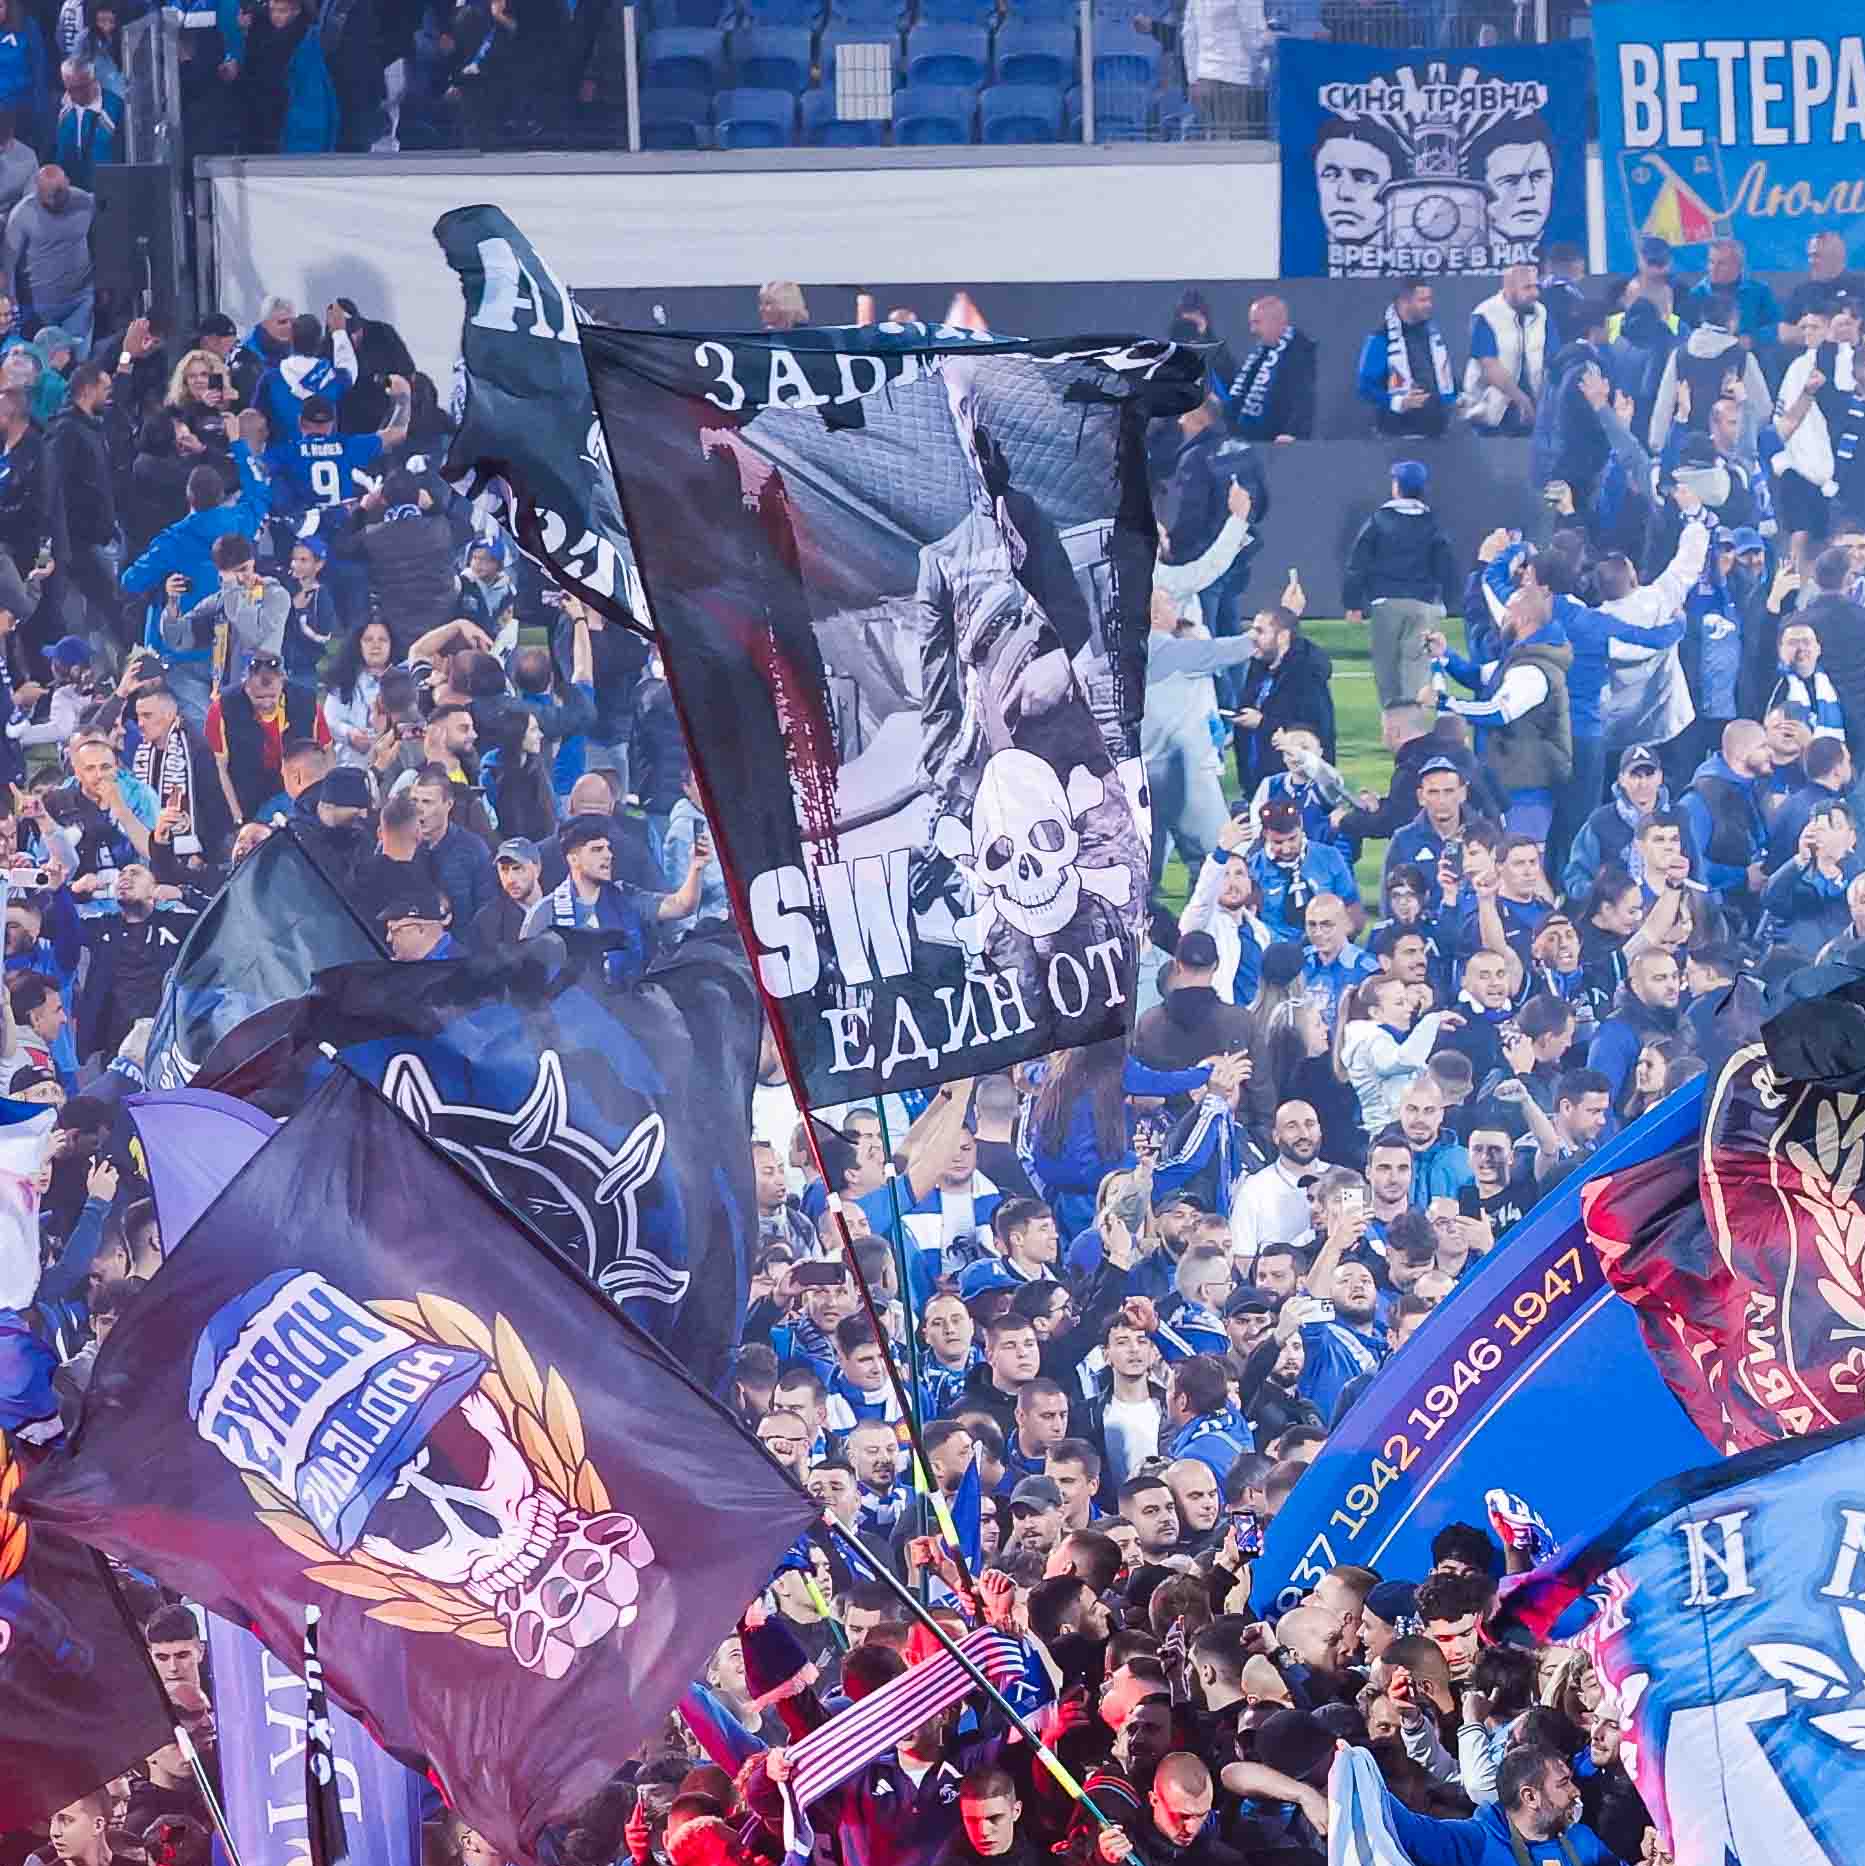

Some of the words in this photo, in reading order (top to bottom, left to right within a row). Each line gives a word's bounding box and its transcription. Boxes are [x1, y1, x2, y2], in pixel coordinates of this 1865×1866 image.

[1326, 85, 1405, 112] СИНЯ
[1423, 83, 1542, 112] ТРЯВНА
[1328, 245, 1442, 269] ВРЕМЕТО
[1448, 246, 1467, 268] Е
[1470, 246, 1487, 267] В
[1494, 241, 1541, 264] НАС
[312, 461, 342, 508] 9
[749, 848, 913, 999] SW
[821, 967, 1035, 1079] ЕДИН
[1046, 938, 1127, 1017] ОТ
[1330, 1433, 1421, 1541] 1942
[1407, 1336, 1503, 1442] 1946
[1493, 1246, 1588, 1347] 1947
